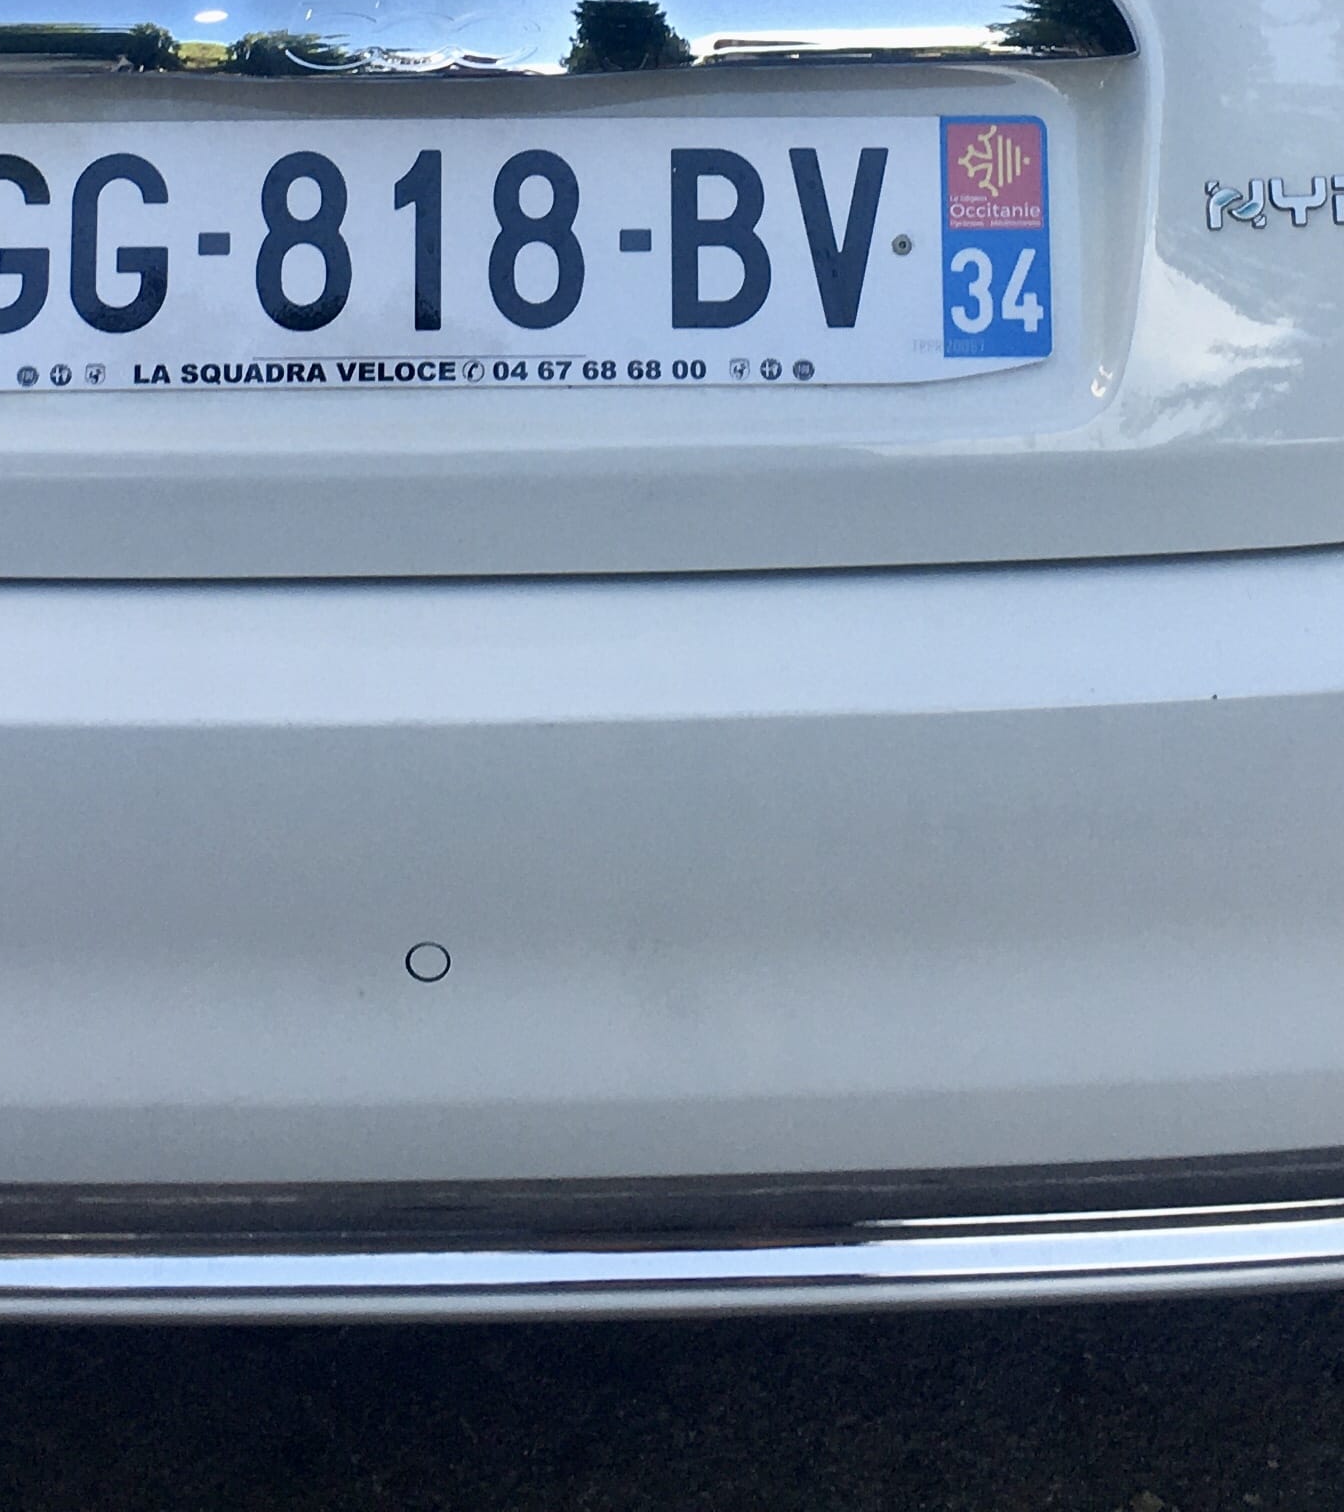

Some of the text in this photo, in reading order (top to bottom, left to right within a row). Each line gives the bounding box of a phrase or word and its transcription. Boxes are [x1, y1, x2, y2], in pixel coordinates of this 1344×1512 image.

[950, 202, 1041, 219] Occitanie
[950, 247, 1044, 334] 34
[133, 359, 707, 386] LA SQUADRA VELOCE 04 67 68 68 00
